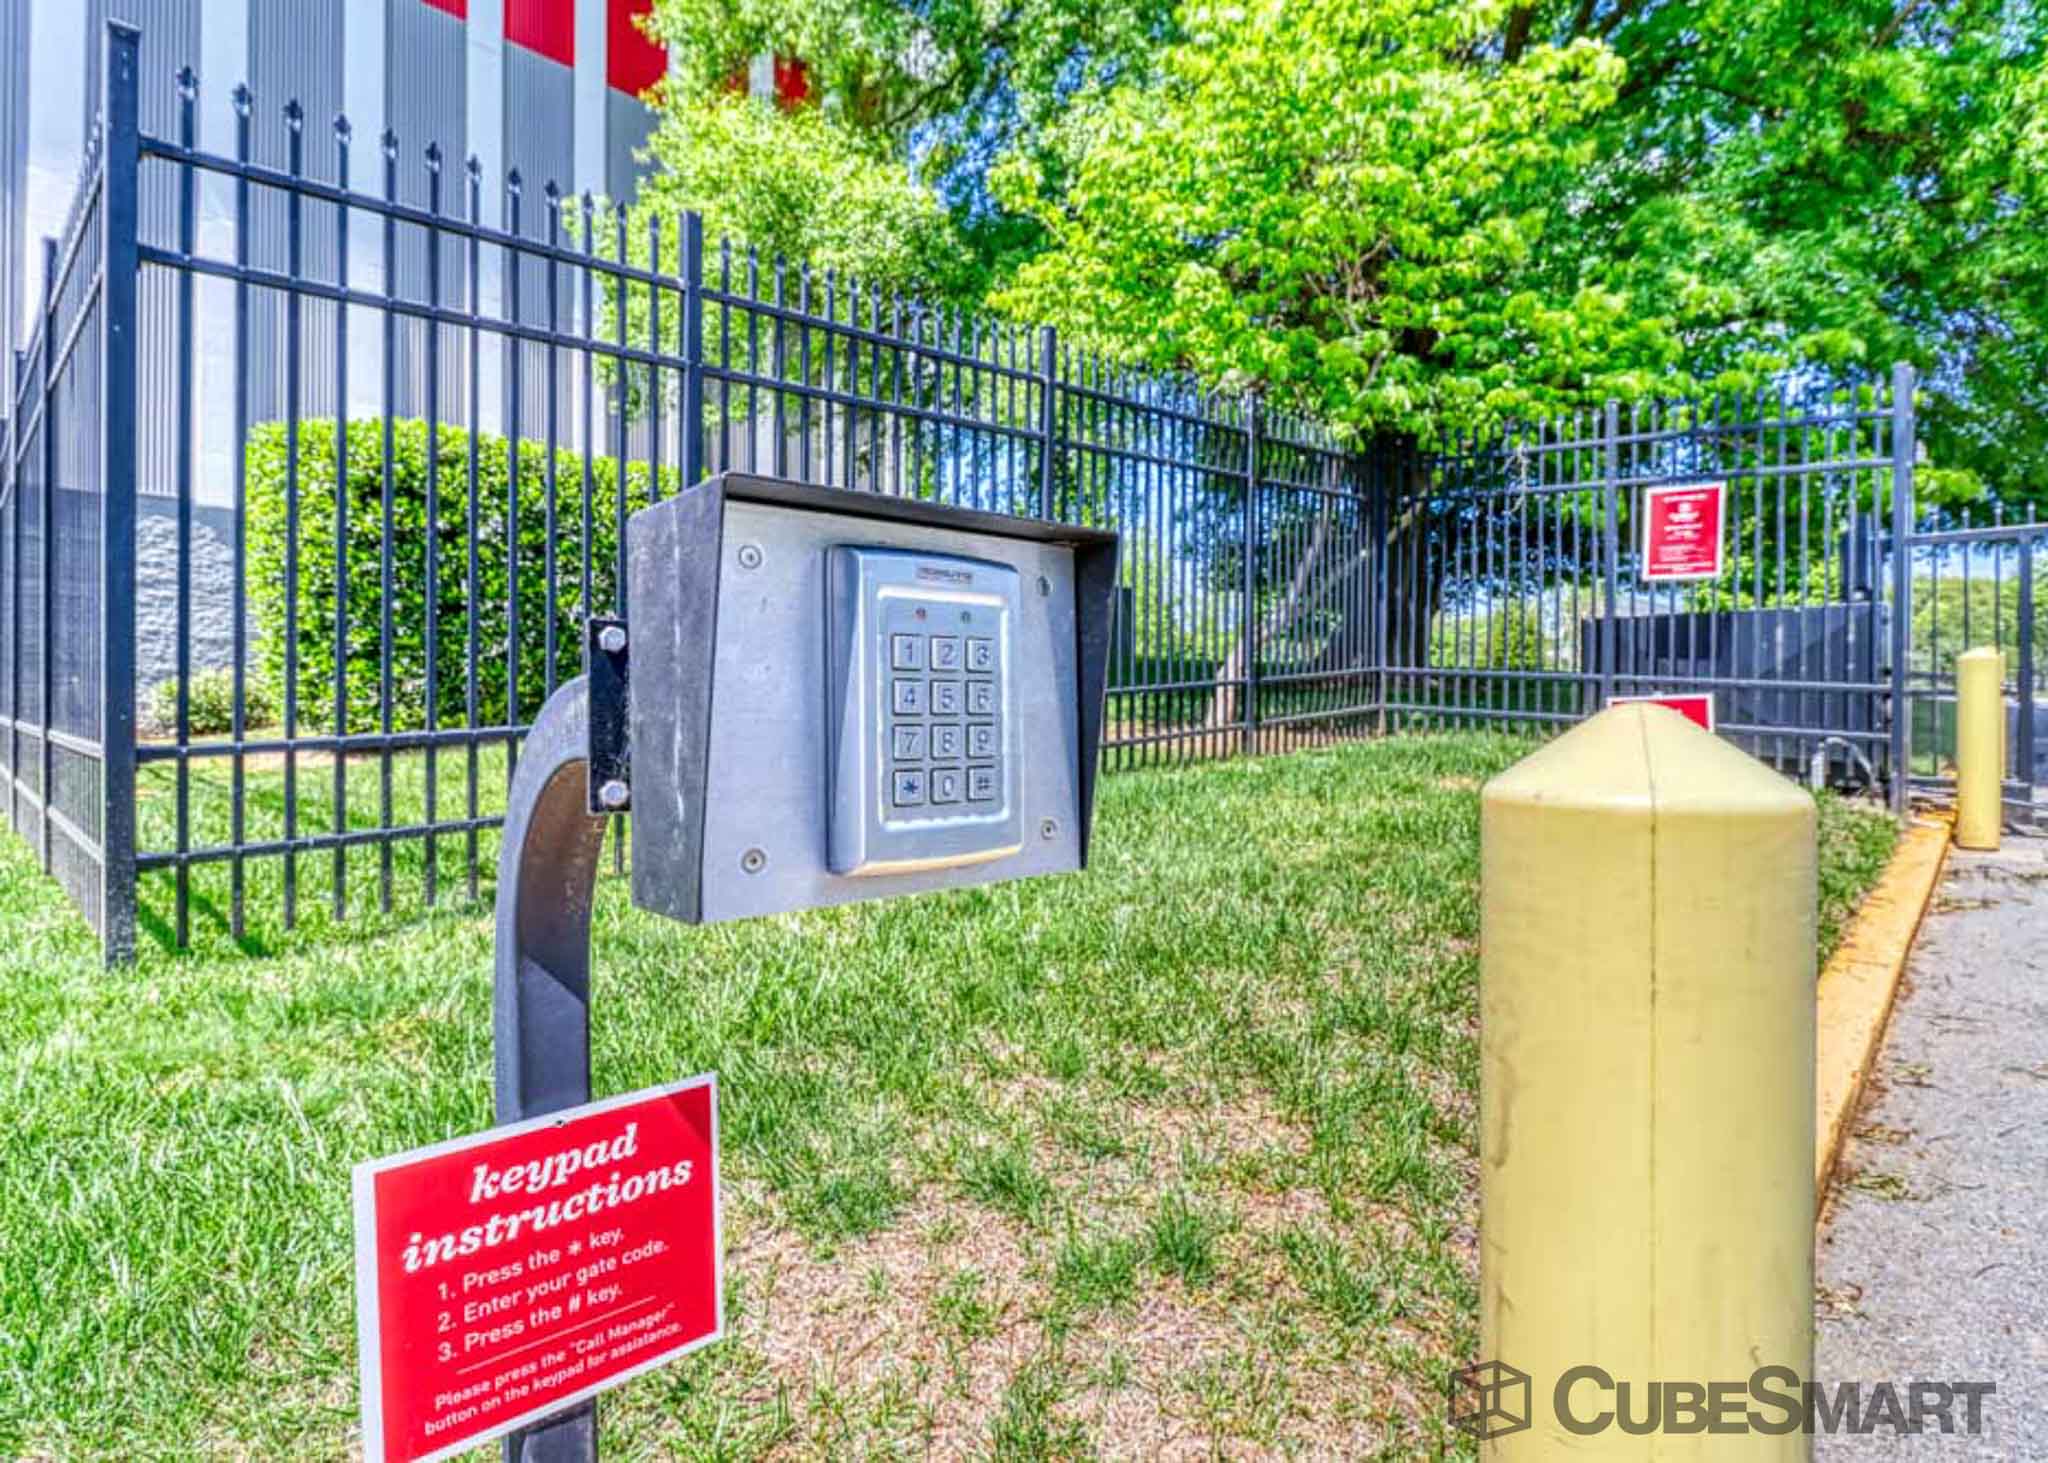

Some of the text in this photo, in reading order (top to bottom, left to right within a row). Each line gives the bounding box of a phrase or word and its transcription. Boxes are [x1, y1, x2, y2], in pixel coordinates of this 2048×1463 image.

[903, 643, 990, 666] 1 2 3
[903, 687, 990, 709] 4 5 6
[903, 729, 989, 752] 7 8 9
[941, 776, 955, 796] 0
[469, 1123, 638, 1203] keypad
[402, 1160, 693, 1273] instructions
[438, 1282, 456, 1300] 1.
[463, 1262, 523, 1292] Press
[528, 1248, 561, 1270] the
[589, 1228, 624, 1250] key.
[438, 1240, 670, 1333] 2. Enter your gate code.
[438, 1342, 457, 1362] 3.
[464, 1320, 525, 1352] Press
[530, 1305, 562, 1328] the
[587, 1283, 623, 1305] key.
[424, 1323, 683, 1436] button on the keypad for assistance.
[435, 1380, 491, 1409] Please
[495, 1360, 537, 1388] press
[541, 1349, 567, 1368] the
